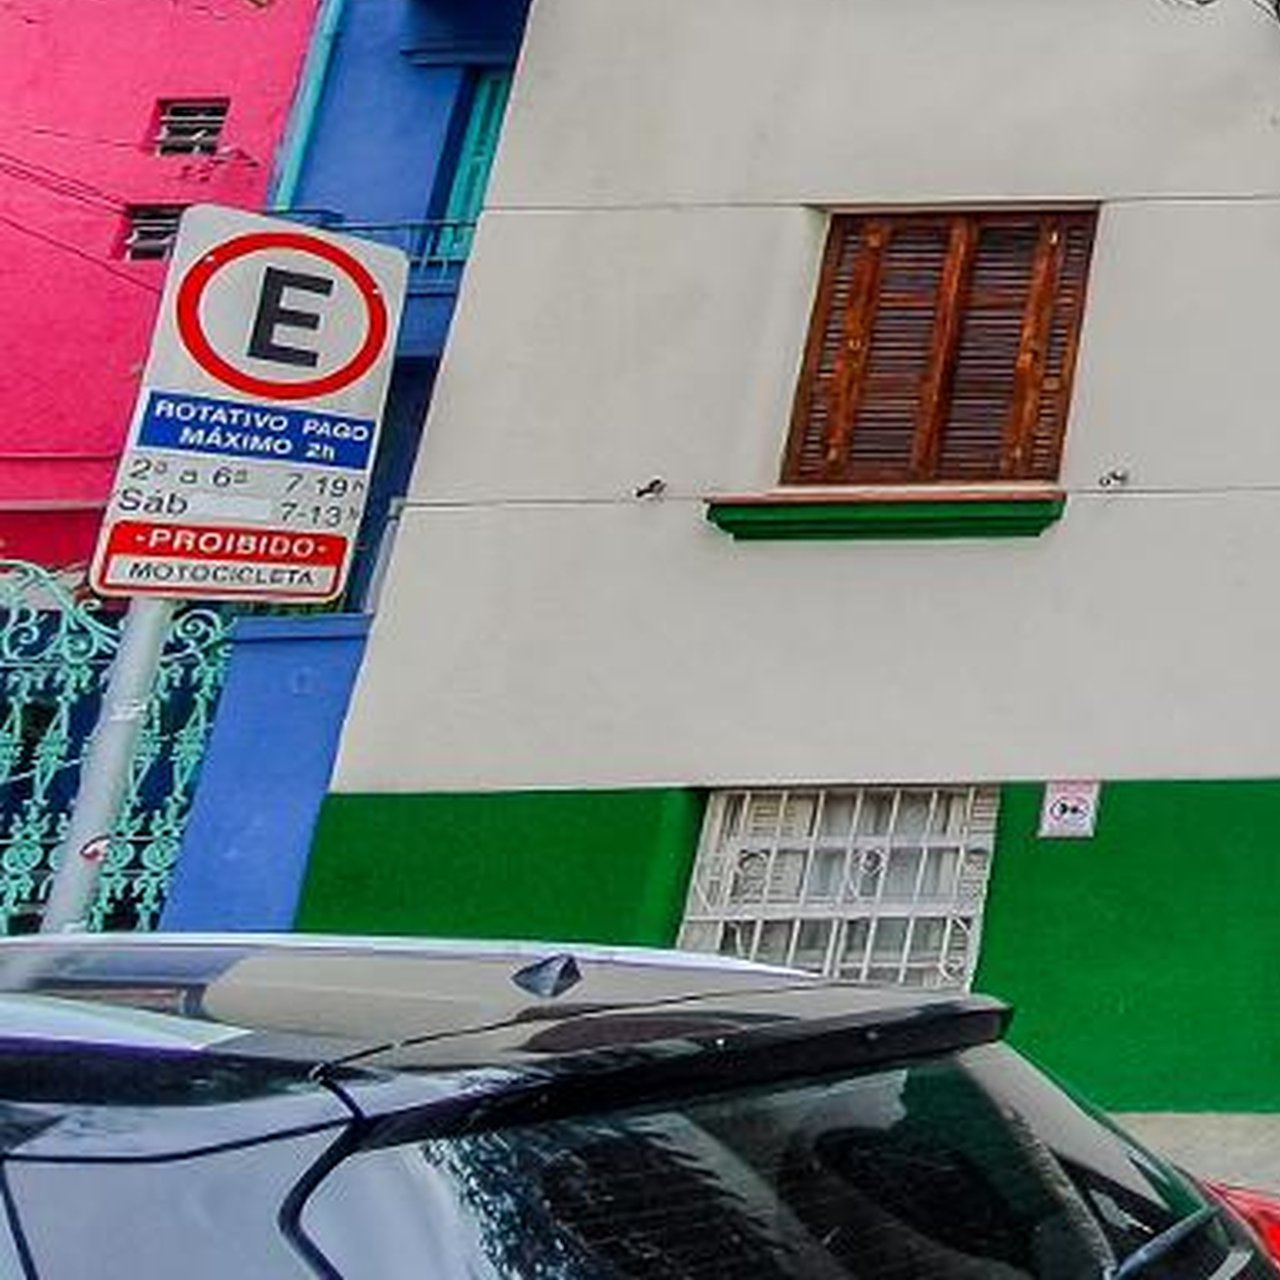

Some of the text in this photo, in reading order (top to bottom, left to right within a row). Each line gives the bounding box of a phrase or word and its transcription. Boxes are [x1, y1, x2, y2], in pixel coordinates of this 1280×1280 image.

[247, 266, 334, 368] E
[155, 399, 369, 442] ROTATIVO PAGO
[179, 426, 335, 461] MÁXIMO 2h
[129, 562, 315, 586] MOTOCICLETA
